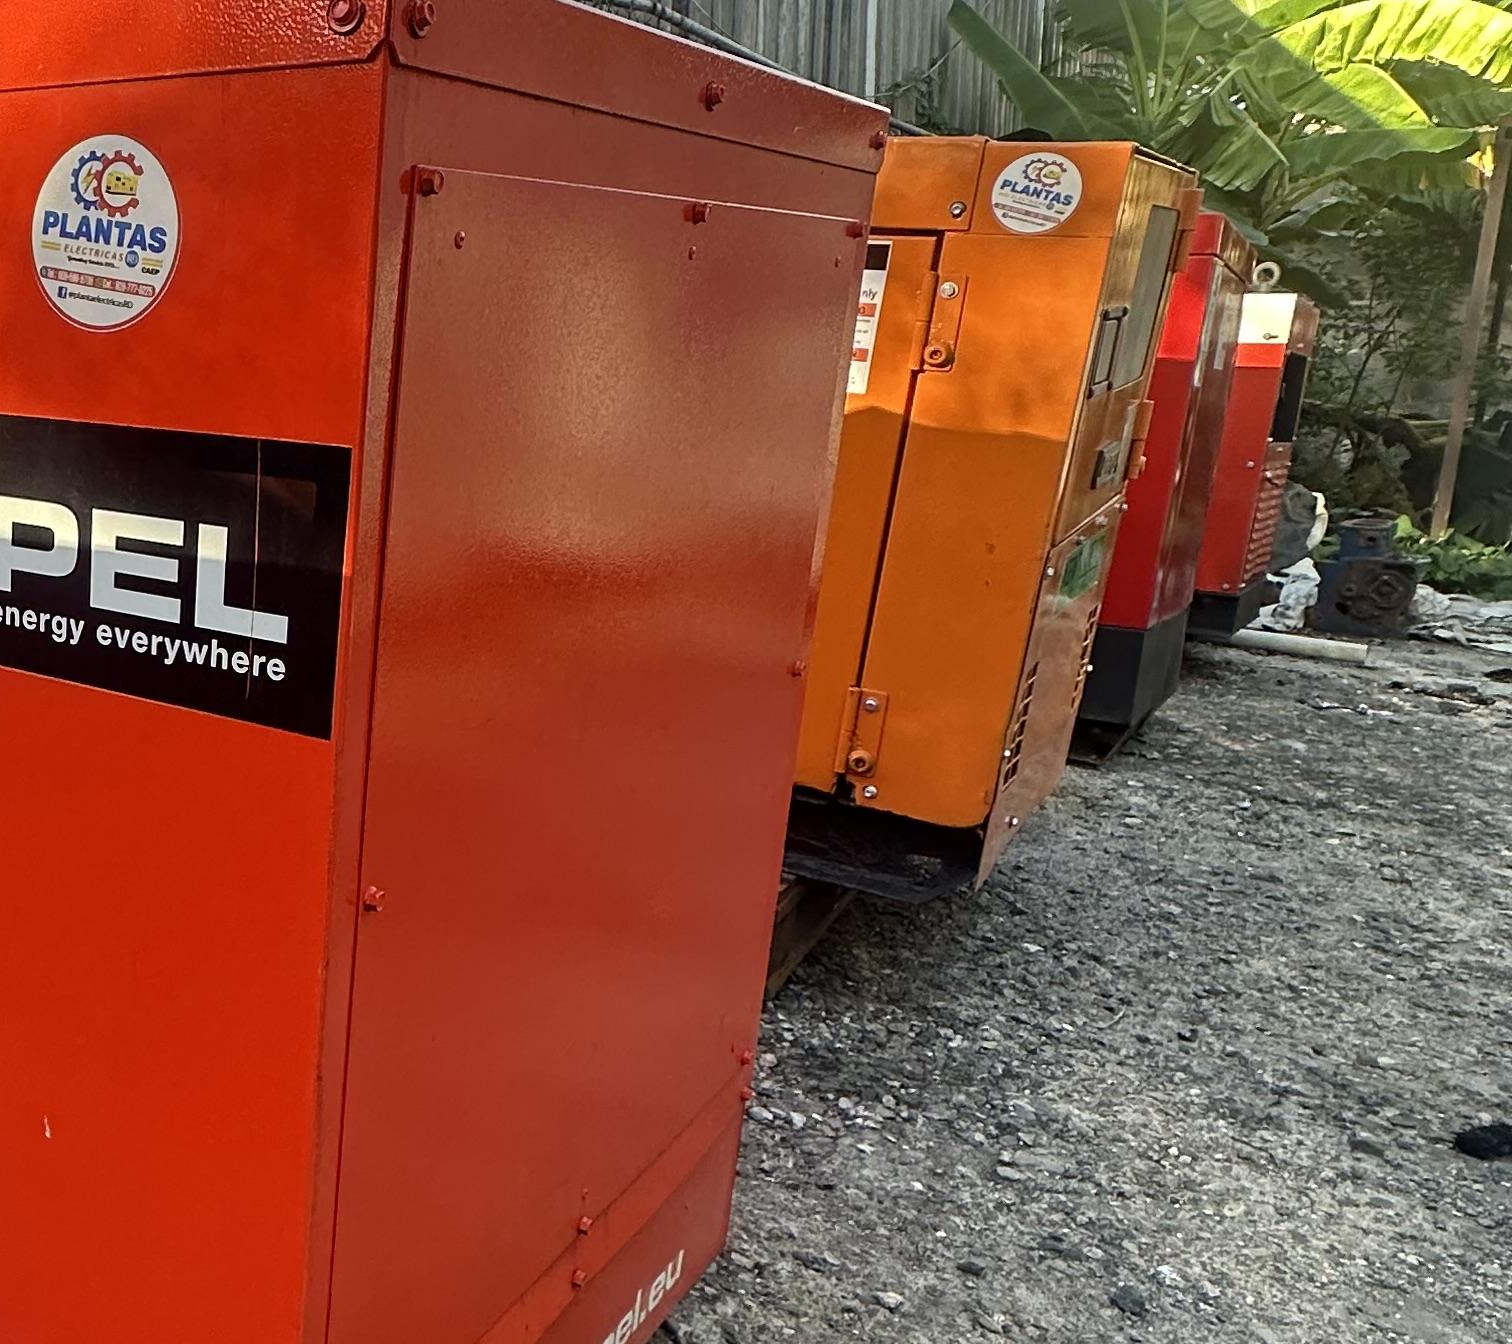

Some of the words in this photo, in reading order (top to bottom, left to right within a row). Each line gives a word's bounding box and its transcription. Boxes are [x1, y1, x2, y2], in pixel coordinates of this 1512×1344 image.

[1000, 179, 1073, 206] PLANTAS
[42, 210, 167, 254] PLANTAS
[63, 243, 124, 262] ELECTRICAS
[96, 623, 286, 682] everywhere
